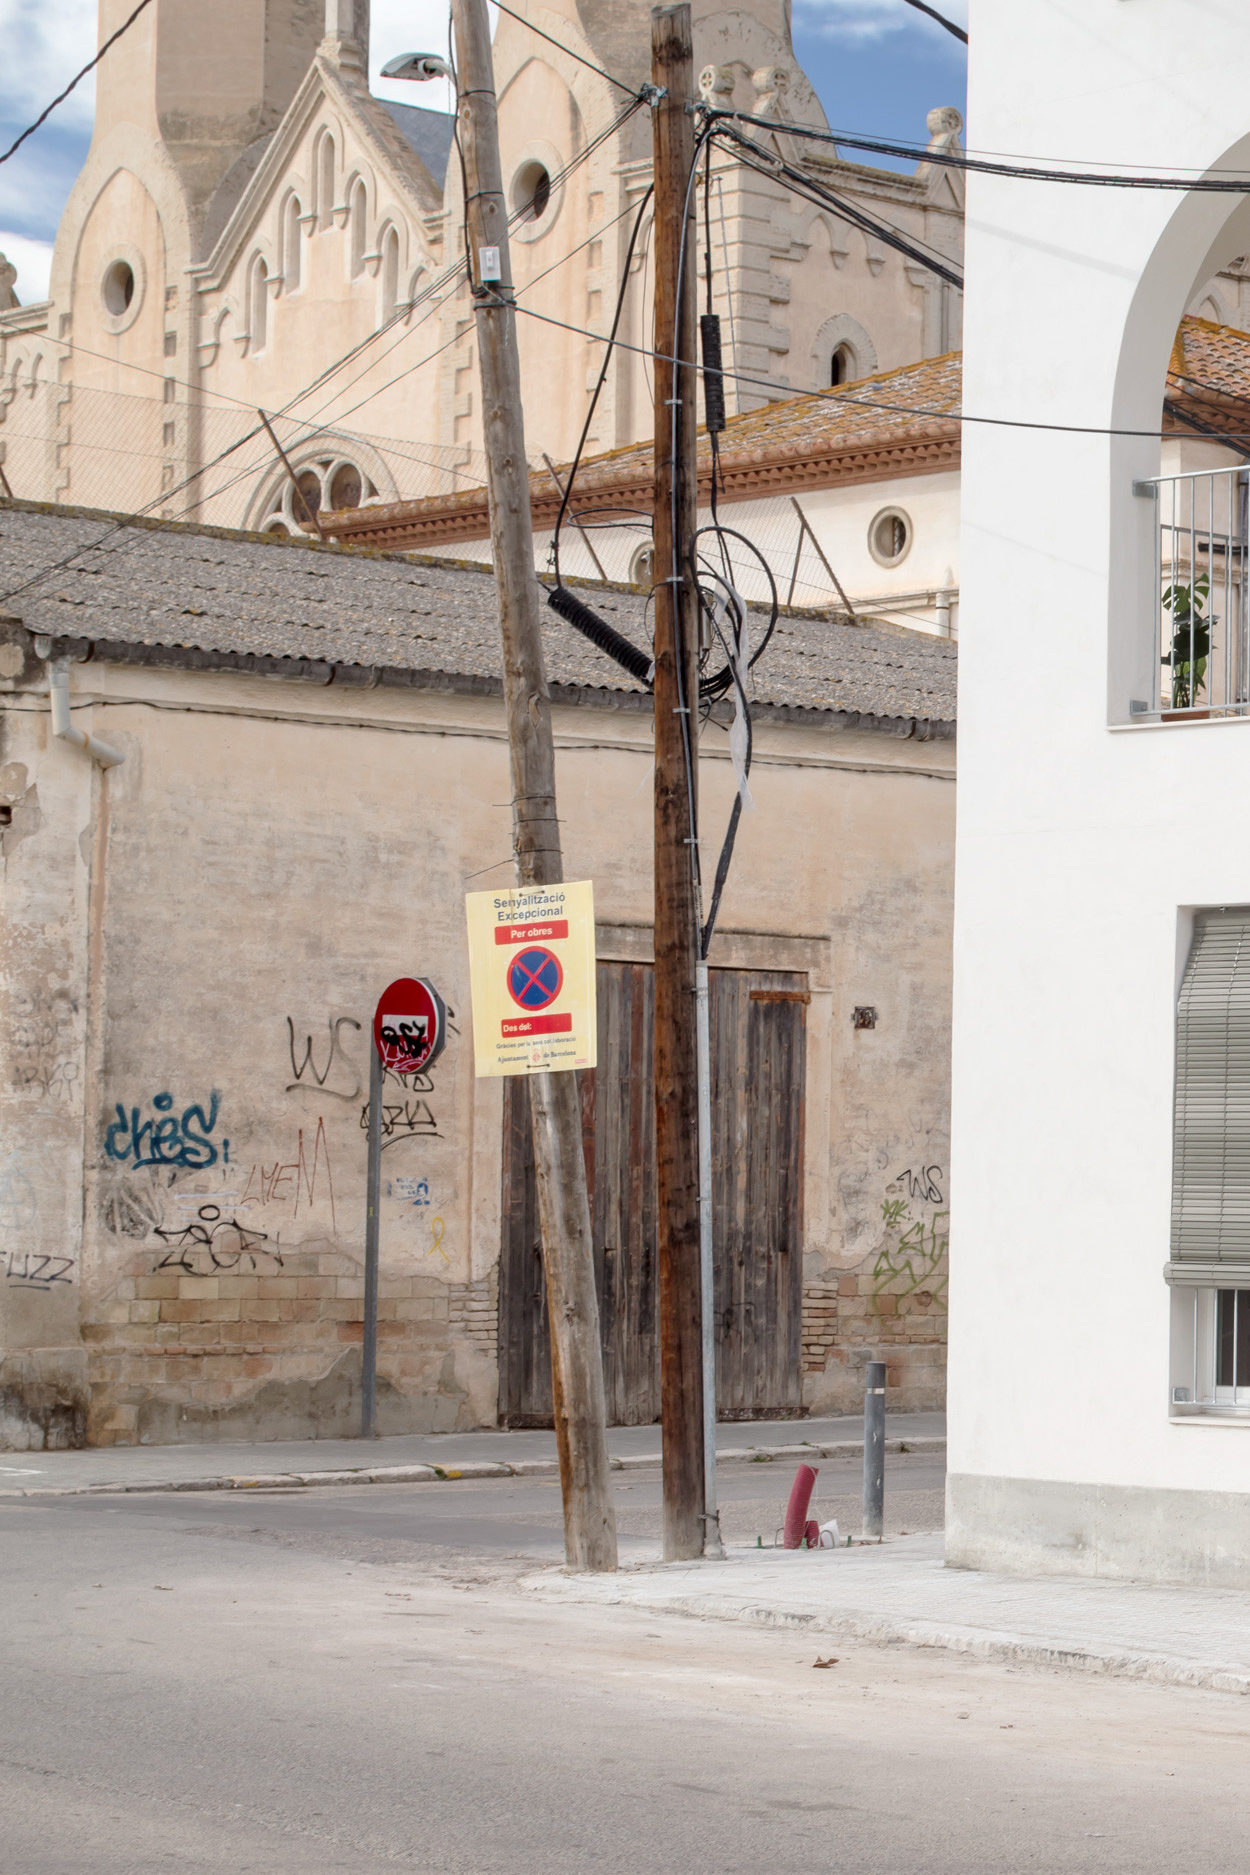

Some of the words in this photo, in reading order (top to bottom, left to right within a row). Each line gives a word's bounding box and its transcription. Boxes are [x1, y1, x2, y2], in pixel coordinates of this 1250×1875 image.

[494, 892, 566, 909] Senyalització
[497, 906, 563, 921] Excepcional
[511, 929, 526, 939] Per
[527, 927, 553, 937] obres
[502, 1024, 518, 1033] Des
[497, 1054, 529, 1063] Ajuntament
[543, 1051, 550, 1059] de
[550, 1049, 577, 1058] Barcelona
